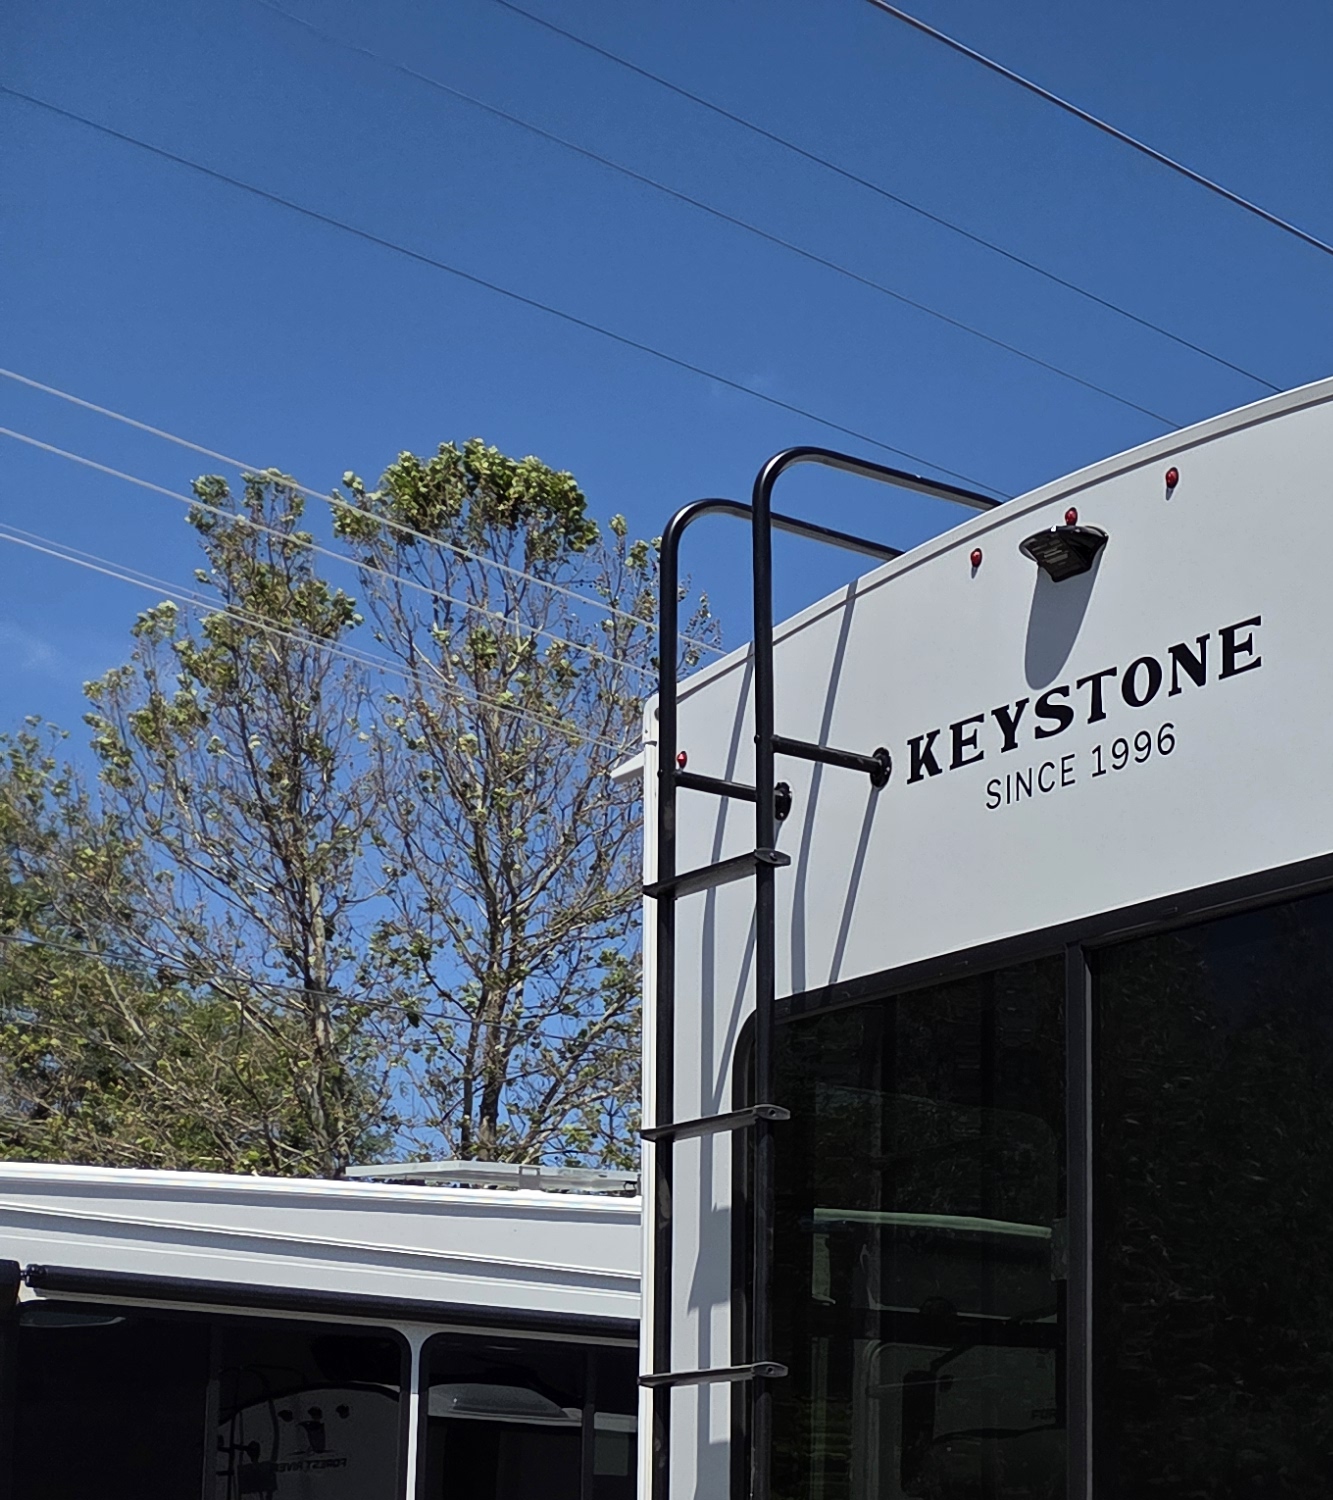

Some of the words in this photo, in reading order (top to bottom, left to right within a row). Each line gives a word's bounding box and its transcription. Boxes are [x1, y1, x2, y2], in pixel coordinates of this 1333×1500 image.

[906, 615, 1262, 785] KEYSTONE
[986, 753, 1076, 810] SINCE
[1091, 722, 1175, 778] 1996
